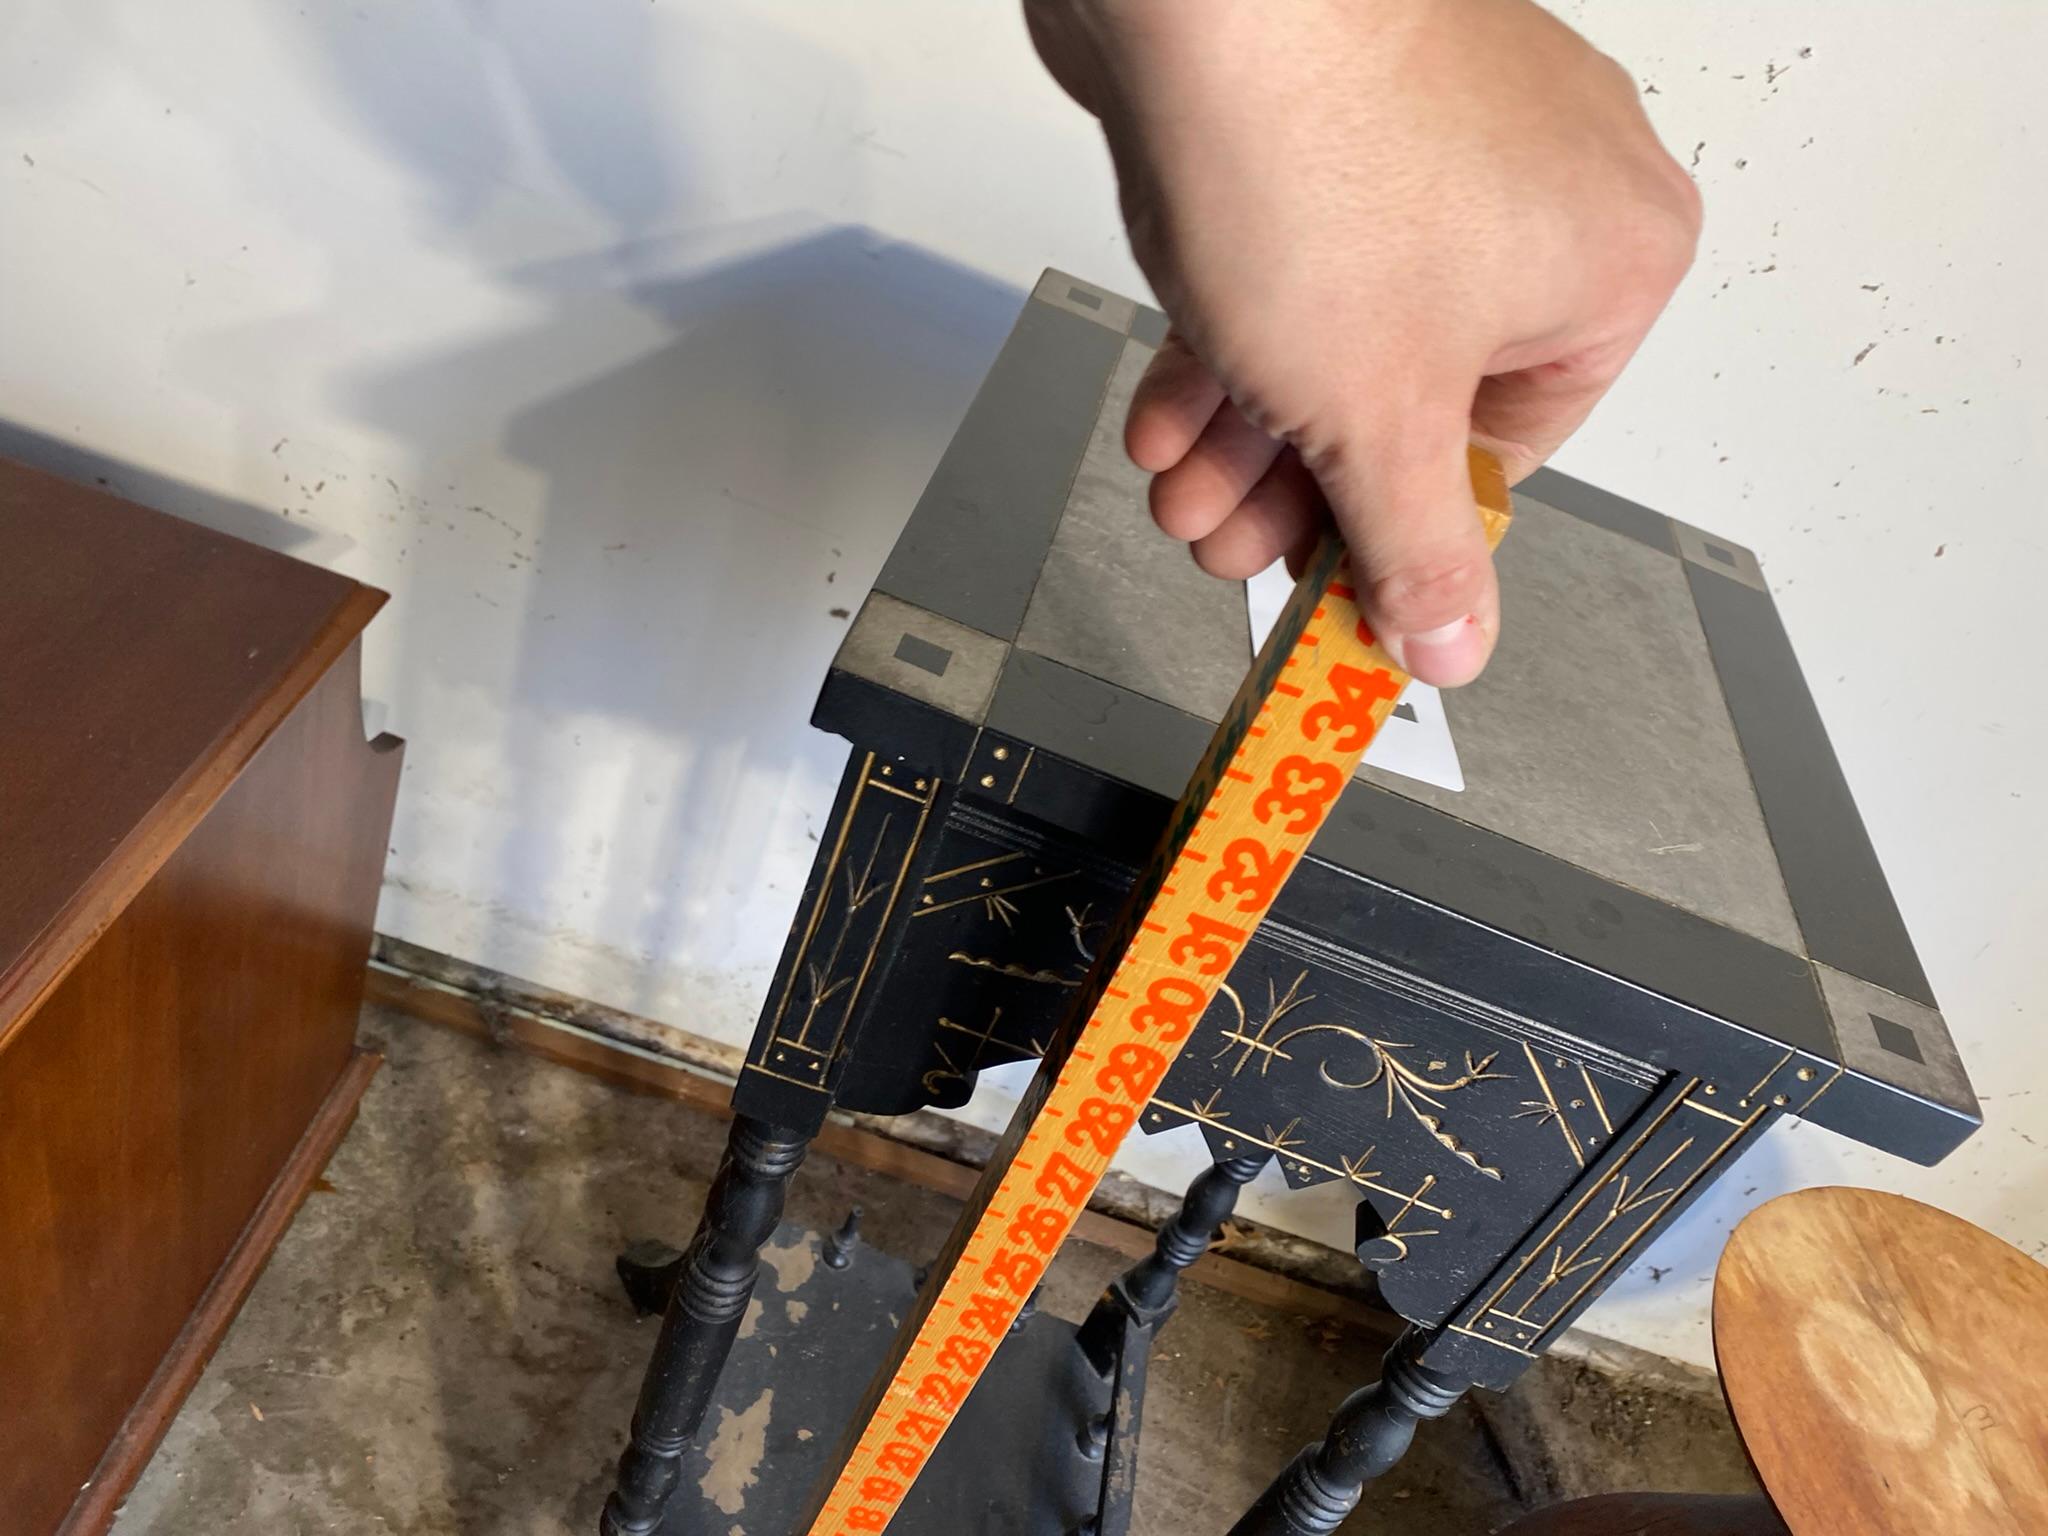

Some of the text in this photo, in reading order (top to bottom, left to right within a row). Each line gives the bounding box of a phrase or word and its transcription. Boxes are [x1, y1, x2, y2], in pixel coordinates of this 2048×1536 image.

[1301, 663, 1400, 752] 34
[1254, 755, 1342, 834] 33
[1207, 838, 1295, 912] 32
[1169, 912, 1249, 975] 31
[1130, 977, 1206, 1042] 30
[1096, 1043, 1167, 1104] 29
[1065, 1098, 1135, 1156] 28
[1035, 1152, 1096, 1207] 27
[1008, 1204, 1069, 1254] 26
[983, 1248, 1043, 1297] 25
[959, 1293, 1016, 1338] 24
[936, 1335, 992, 1377] 23
[914, 1373, 970, 1414] 22
[896, 1410, 947, 1445] 21
[876, 1442, 925, 1477] 20
[859, 1476, 904, 1503] 19
[844, 1506, 888, 1532] 18
